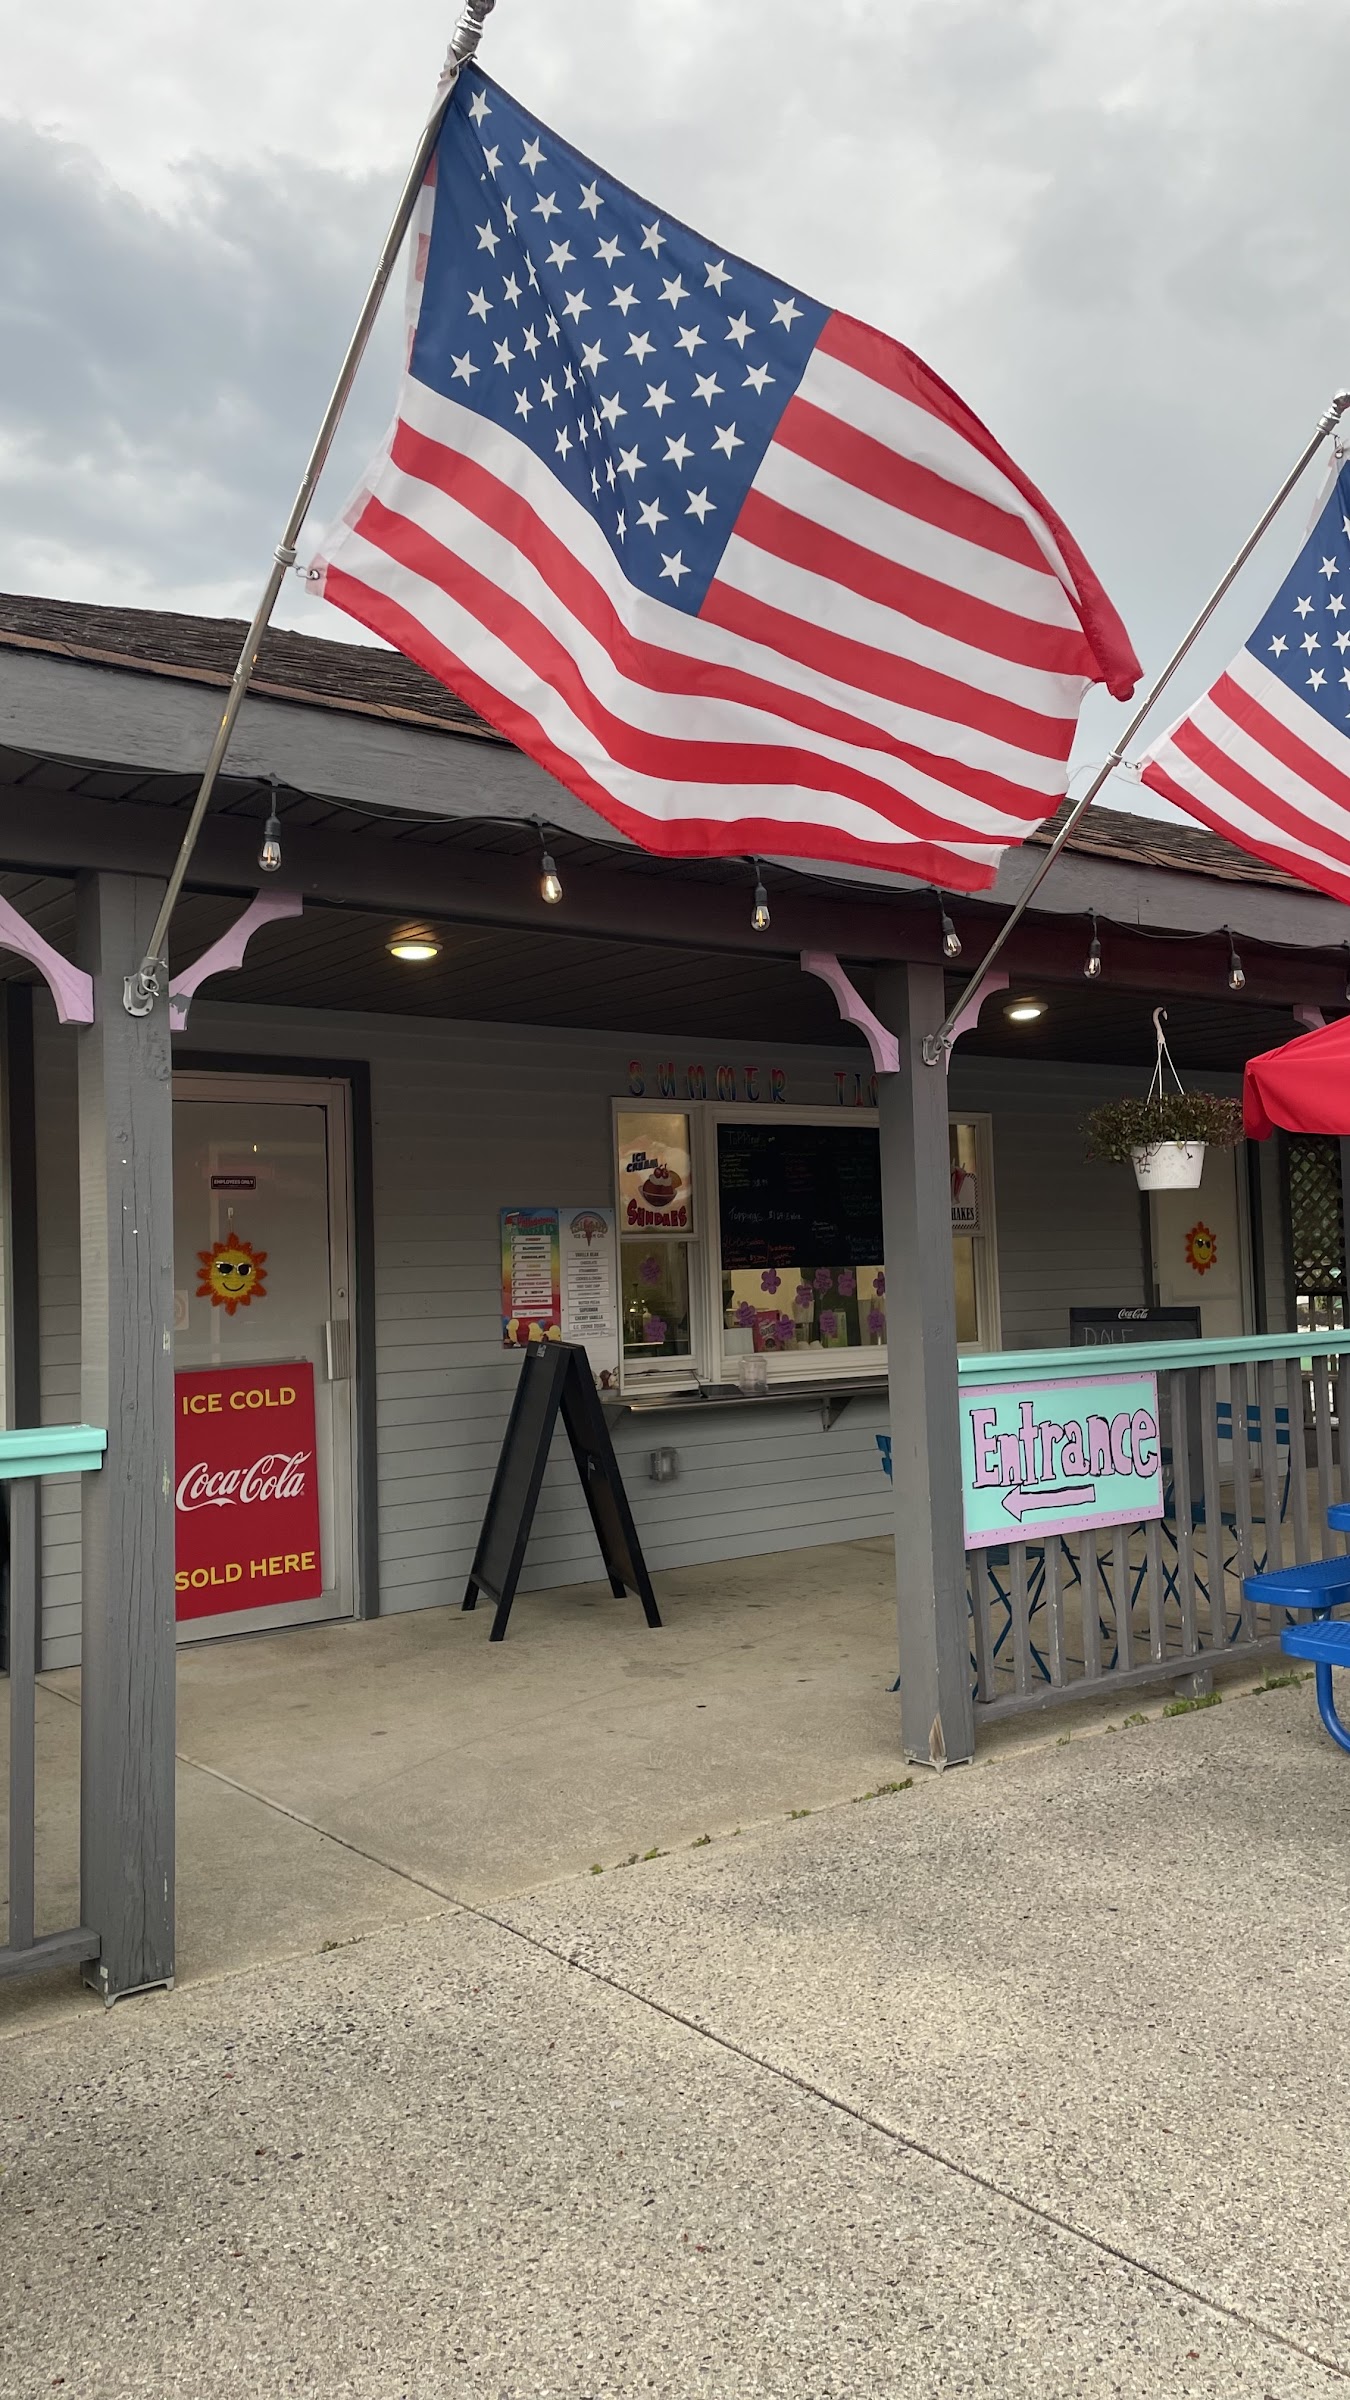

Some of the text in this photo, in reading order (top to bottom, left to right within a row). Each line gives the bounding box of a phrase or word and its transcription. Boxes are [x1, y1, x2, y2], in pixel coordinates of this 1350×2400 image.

[629, 1060, 787, 1103] SUMMER
[626, 1159, 659, 1173] CREAM
[632, 1152, 646, 1163] ICE
[626, 1199, 687, 1227] SUNDAES
[951, 1207, 975, 1220] HAKES
[182, 1387, 296, 1415] ICE COLD
[969, 1401, 1159, 1489] Entrance
[175, 1450, 312, 1512] Coca-Cola
[175, 1551, 316, 1591] SOLD HERE
